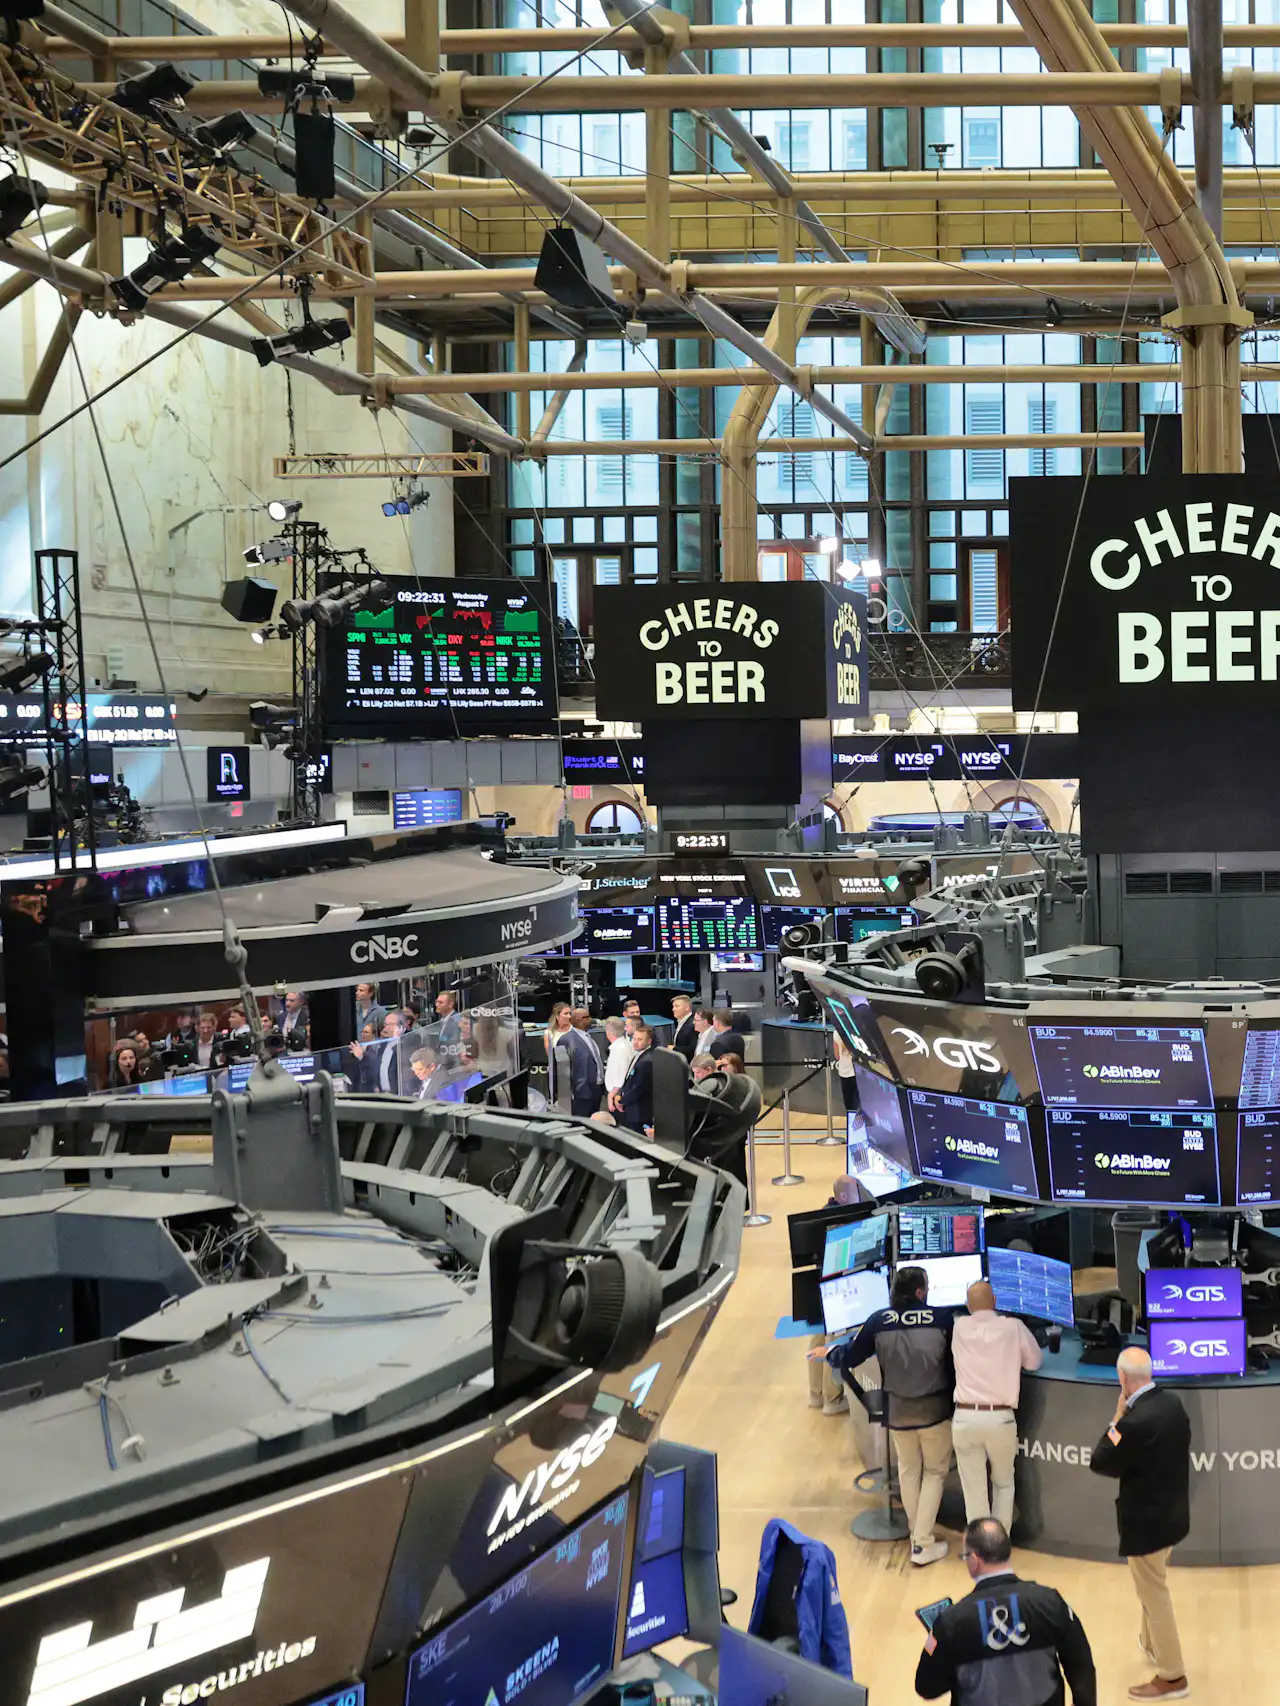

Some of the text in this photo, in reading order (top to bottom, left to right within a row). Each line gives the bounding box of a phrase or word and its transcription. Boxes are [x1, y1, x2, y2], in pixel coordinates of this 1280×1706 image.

[1190, 574, 1232, 601] TO
[398, 592, 446, 604] 09:22:31
[452, 592, 488, 601] Wednesday
[457, 600, 479, 608] August
[640, 599, 779, 651] CHEERS
[399, 633, 412, 644] VIX
[448, 635, 464, 645] DXY
[697, 640, 721, 657] TO
[655, 661, 766, 705] BEER
[838, 753, 879, 765] BayCrest
[676, 834, 726, 848] 9:22:31
[839, 878, 880, 887] VIRTU
[350, 934, 419, 964] CNBC
[1036, 1028, 1056, 1036] BUD
[933, 1037, 1001, 1073] GTS
[1100, 1065, 1160, 1078] ABInBev
[1052, 1112, 1072, 1121] BUD
[1099, 1112, 1127, 1121] 84.5900
[1150, 1113, 1170, 1122] 85.23
[1245, 1114, 1266, 1123] BUD
[1184, 1130, 1202, 1138] BUD
[1183, 1143, 1204, 1151] NYSE
[1110, 1154, 1171, 1170] ABInBev
[1186, 1286, 1225, 1302] GTS
[901, 1310, 934, 1326] GTS
[1190, 1339, 1228, 1358] GTS
[1016, 1438, 1091, 1466] HANGE
[627, 1614, 666, 1640] Securities
[420, 1627, 448, 1670] SKE
[160, 1635, 317, 1706] Securities
[506, 1636, 560, 1692] SKEENA
